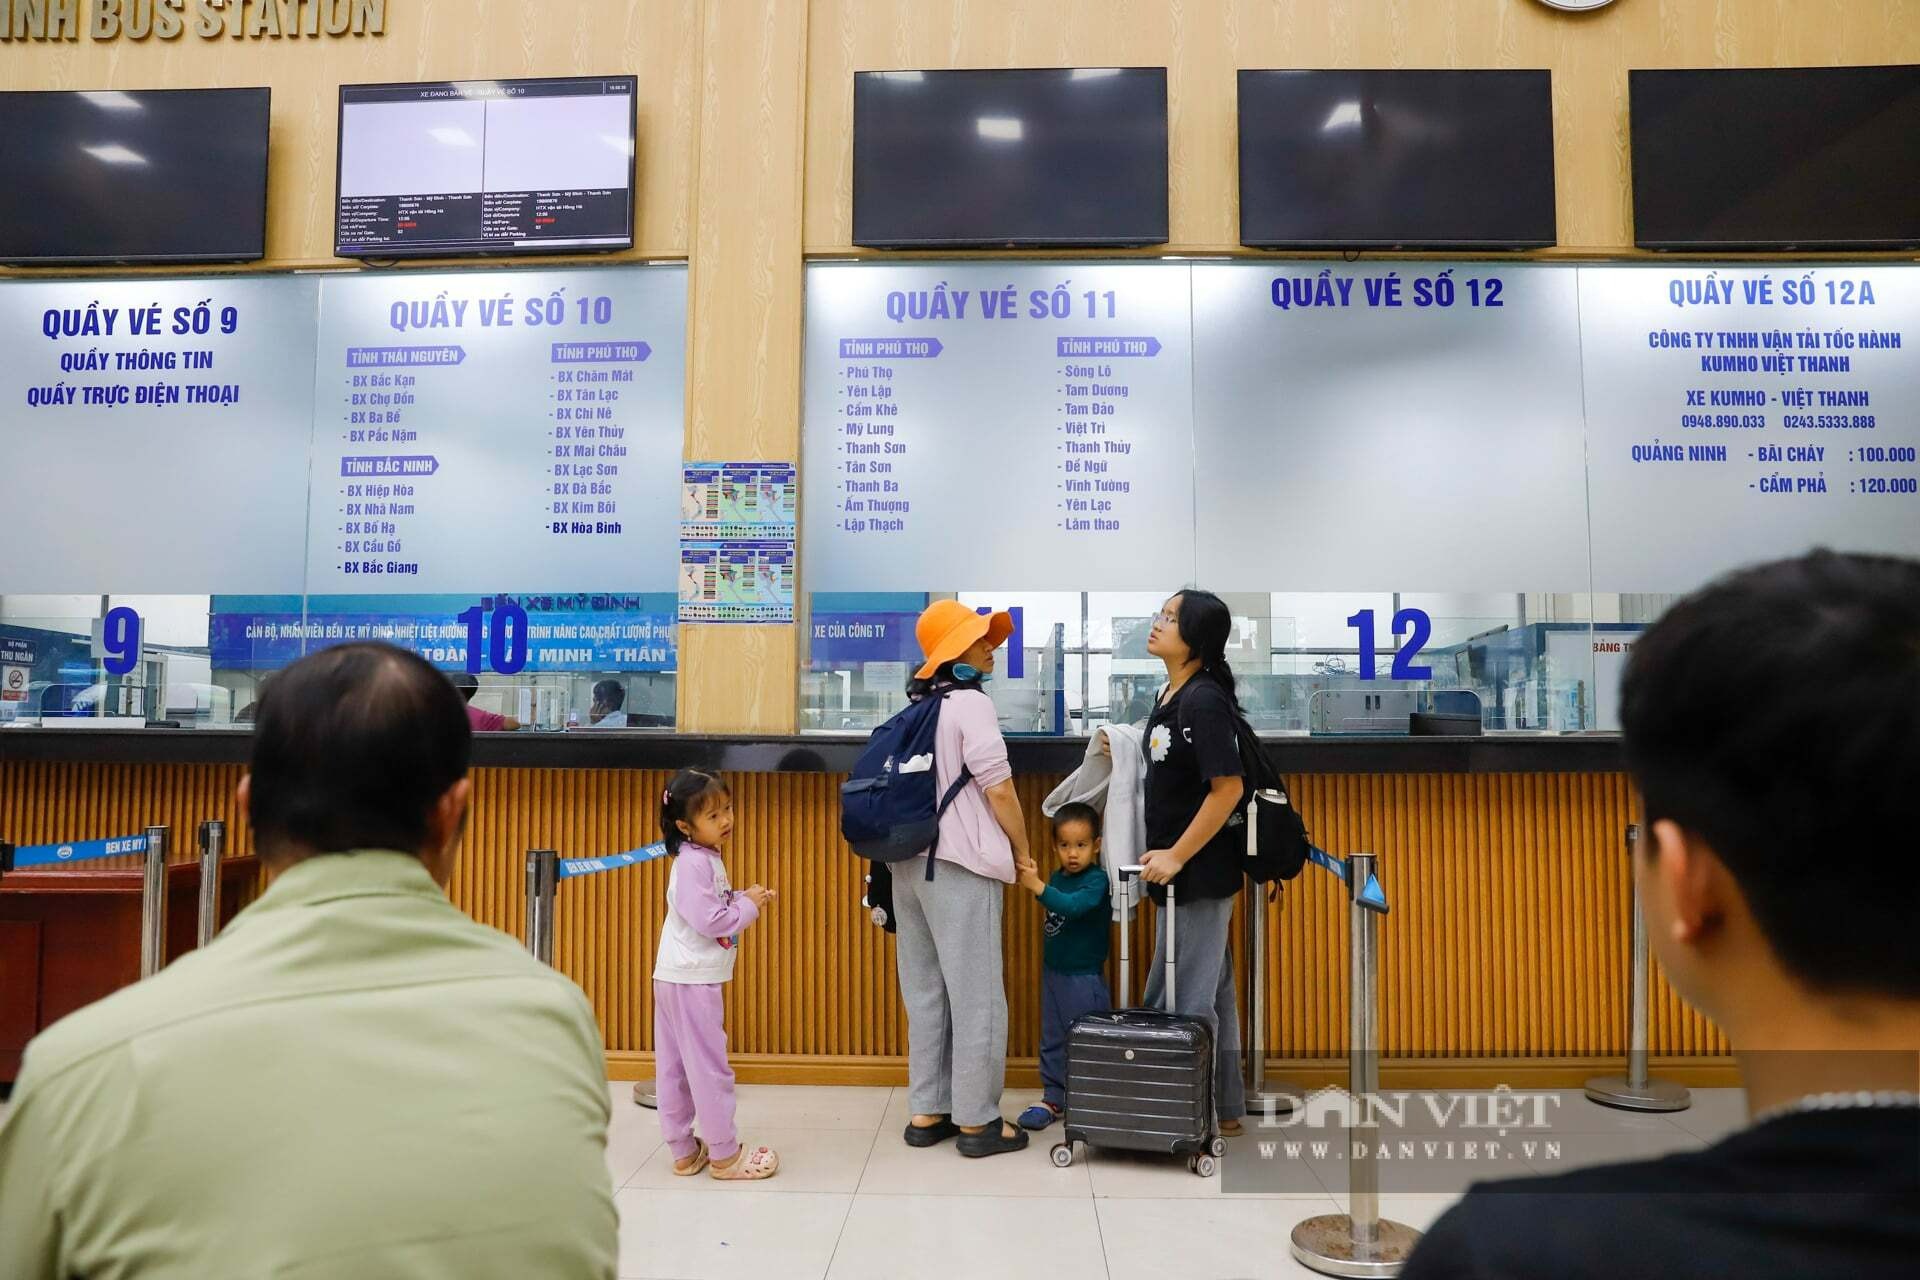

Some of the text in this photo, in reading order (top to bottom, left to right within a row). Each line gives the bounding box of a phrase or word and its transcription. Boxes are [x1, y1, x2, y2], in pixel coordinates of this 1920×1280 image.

[91, 0, 184, 39] BUS
[194, 0, 386, 39] STATION
[1272, 269, 1503, 309] QUẦY VÉ SỐ 12
[1670, 271, 1875, 307] QUẦY VÉ SỐ 12A
[886, 280, 1117, 323] QUẦY VÉ SỐ 11
[390, 287, 613, 333] QUẦY VÉ SỐ 10
[43, 299, 237, 340] QUẦY VÉ SỐ 9
[1063, 338, 1090, 353] TỈNH
[1649, 328, 1901, 352] CÔNG TY TNHH VẬN TẢI TỐC HÀNH
[352, 349, 378, 363] TỈNH
[556, 345, 584, 359] TỈNH
[844, 340, 872, 358] TỈNH
[61, 347, 212, 373] QUẦY THÔNG TIN
[1702, 353, 1849, 375] KUMHO VIỆT THANH
[353, 376, 367, 387] BX
[559, 371, 572, 382] BX
[28, 382, 239, 408] QUẦY TRỰC ĐIỆN THOẠI
[558, 390, 572, 401] BX
[599, 389, 618, 403] Lạc
[1065, 384, 1088, 396] Tam
[352, 394, 366, 405] BX
[1687, 388, 1869, 409] XE KUMHO VIỆT THANH
[557, 408, 571, 419] BX
[1065, 403, 1088, 415] Tam
[351, 412, 382, 423] BX Ba
[1682, 415, 1765, 428] 0948.890.033
[1784, 416, 1875, 428] 0243.5333.888
[350, 430, 364, 442] BX
[556, 427, 571, 438] BX
[867, 423, 893, 436] Lung
[1066, 422, 1087, 436] Việt
[556, 445, 594, 457] BX Mai
[846, 442, 880, 454] Thanh
[1065, 441, 1100, 453] Thanh
[1632, 441, 1726, 462] QUẢNG NINH
[1758, 444, 1824, 461] BÃI CHÁY
[1858, 447, 1915, 462] 100.000
[347, 458, 372, 472] TỈNH
[403, 460, 432, 472] NINH
[555, 464, 569, 476] BX
[573, 464, 592, 478] Lạc
[554, 483, 568, 494] BX
[845, 480, 898, 492] Thanh Ba
[1760, 472, 1826, 492] CẨM PHẢ
[1860, 478, 1917, 493] 120.000
[348, 485, 362, 496] BX
[366, 485, 389, 499] Hiệp
[347, 504, 361, 515] BX
[390, 503, 414, 514] Nam
[554, 502, 593, 513] BX Kim
[1091, 499, 1111, 513] Lạc
[346, 522, 360, 534] BX
[553, 522, 567, 533] BX
[597, 522, 621, 533] Bình
[869, 519, 903, 533] Thạch
[1094, 518, 1119, 530] thao
[345, 541, 359, 552] BX
[345, 562, 359, 573] BX
[387, 562, 417, 574] Giang
[526, 596, 553, 611] XE
[344, 625, 356, 638] XE
[814, 620, 886, 638] XE CỦA CÔNG TY
[103, 606, 140, 676] 9
[457, 604, 528, 675] 10
[1347, 607, 1432, 681] 12
[539, 648, 592, 662] MINH
